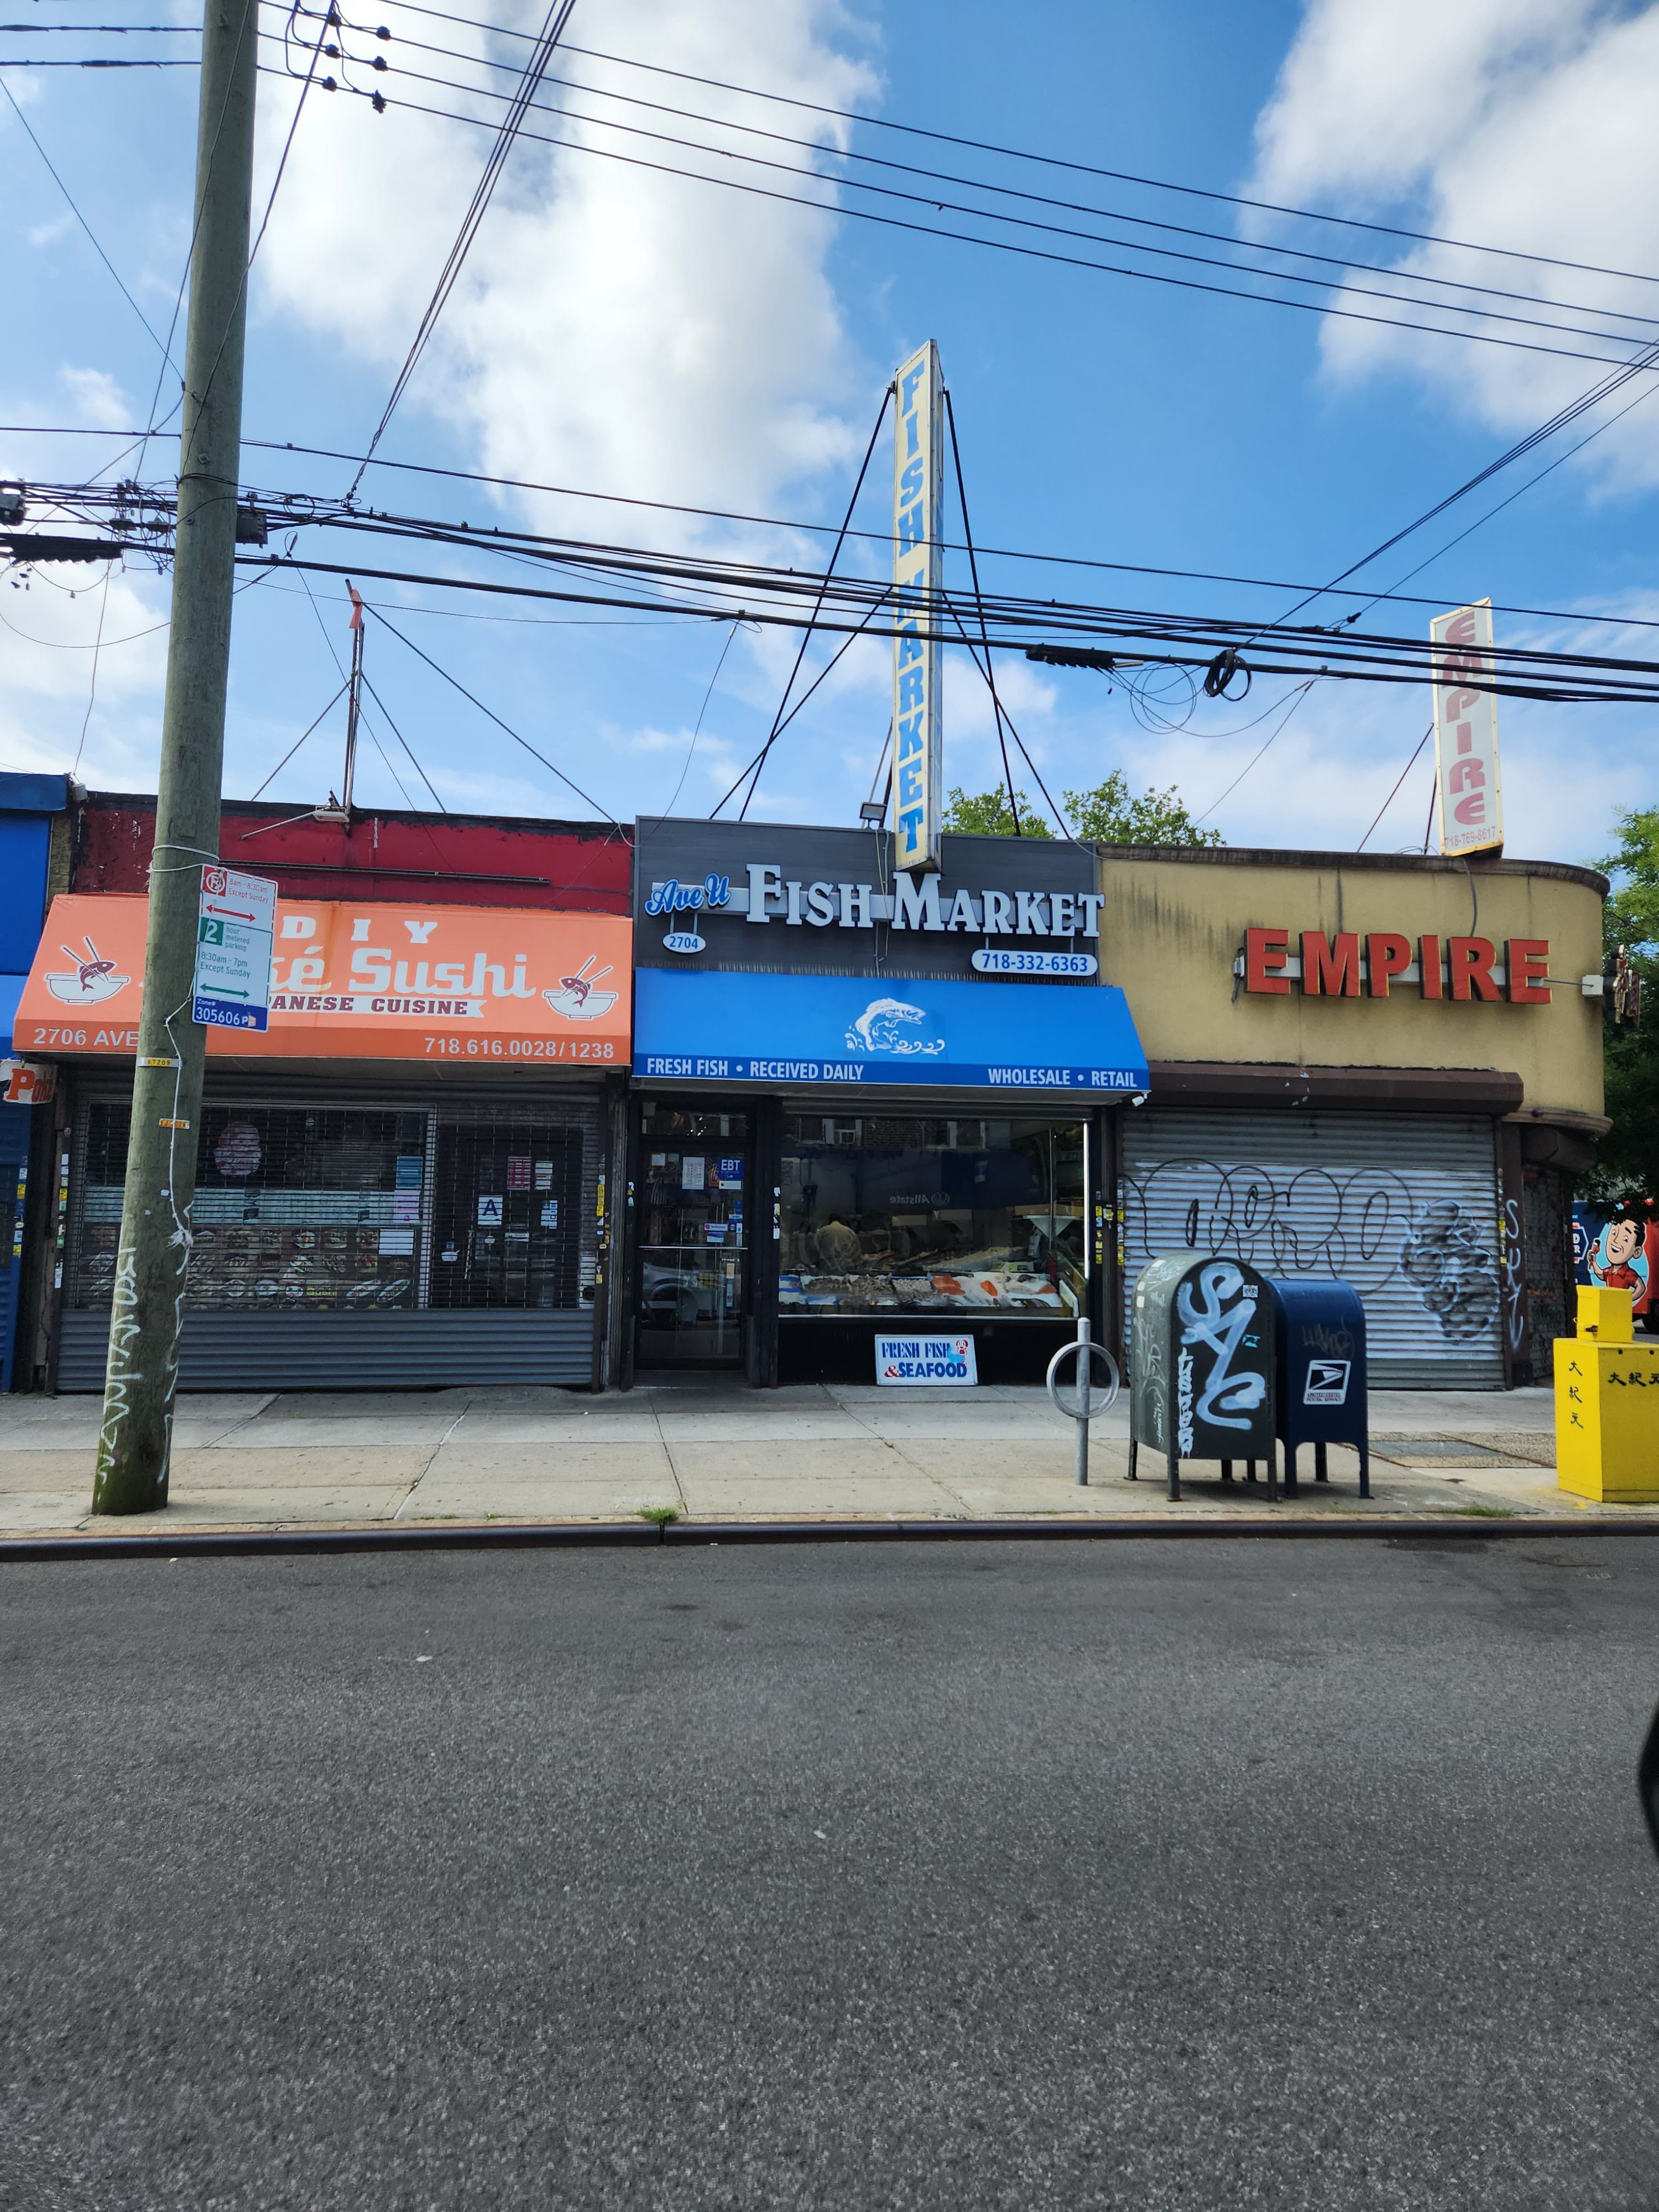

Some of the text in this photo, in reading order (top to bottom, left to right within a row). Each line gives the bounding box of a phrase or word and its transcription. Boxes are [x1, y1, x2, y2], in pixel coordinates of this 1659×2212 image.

[896, 358, 924, 853] FISH MARKET
[1442, 611, 1486, 826] EMPIRE
[229, 878, 242, 886] 8am
[229, 888, 269, 904] Except Sunday
[645, 863, 1105, 938] Ave U FISH MARKET
[205, 920, 218, 943] 2
[226, 926, 239, 934] hour
[226, 934, 250, 945] metered
[225, 942, 247, 952] parking
[669, 937, 699, 950] 2704
[201, 951, 227, 964] 8:30am
[234, 958, 248, 968] 7pm
[982, 953, 1088, 972] 718-332-6363
[1244, 927, 1552, 1004] EMPIRE
[200, 962, 251, 979] Except Sunday
[348, 947, 536, 998] Sushi
[270, 995, 468, 1015] ANESE CUISINE
[196, 1006, 240, 1025] 305606
[33, 1027, 139, 1047] 2706 AVE
[424, 1037, 615, 1058] 718.616.0028/1238
[646, 1057, 864, 1081] FRESH FISH RECEIVED DAILY
[988, 1068, 1138, 1088] WHOLESALE RETAIL
[721, 1159, 740, 1171] EBT
[482, 1199, 498, 1216] A
[881, 1342, 950, 1358] FRESH FISH
[1568, 1360, 1584, 1430] 大紀元
